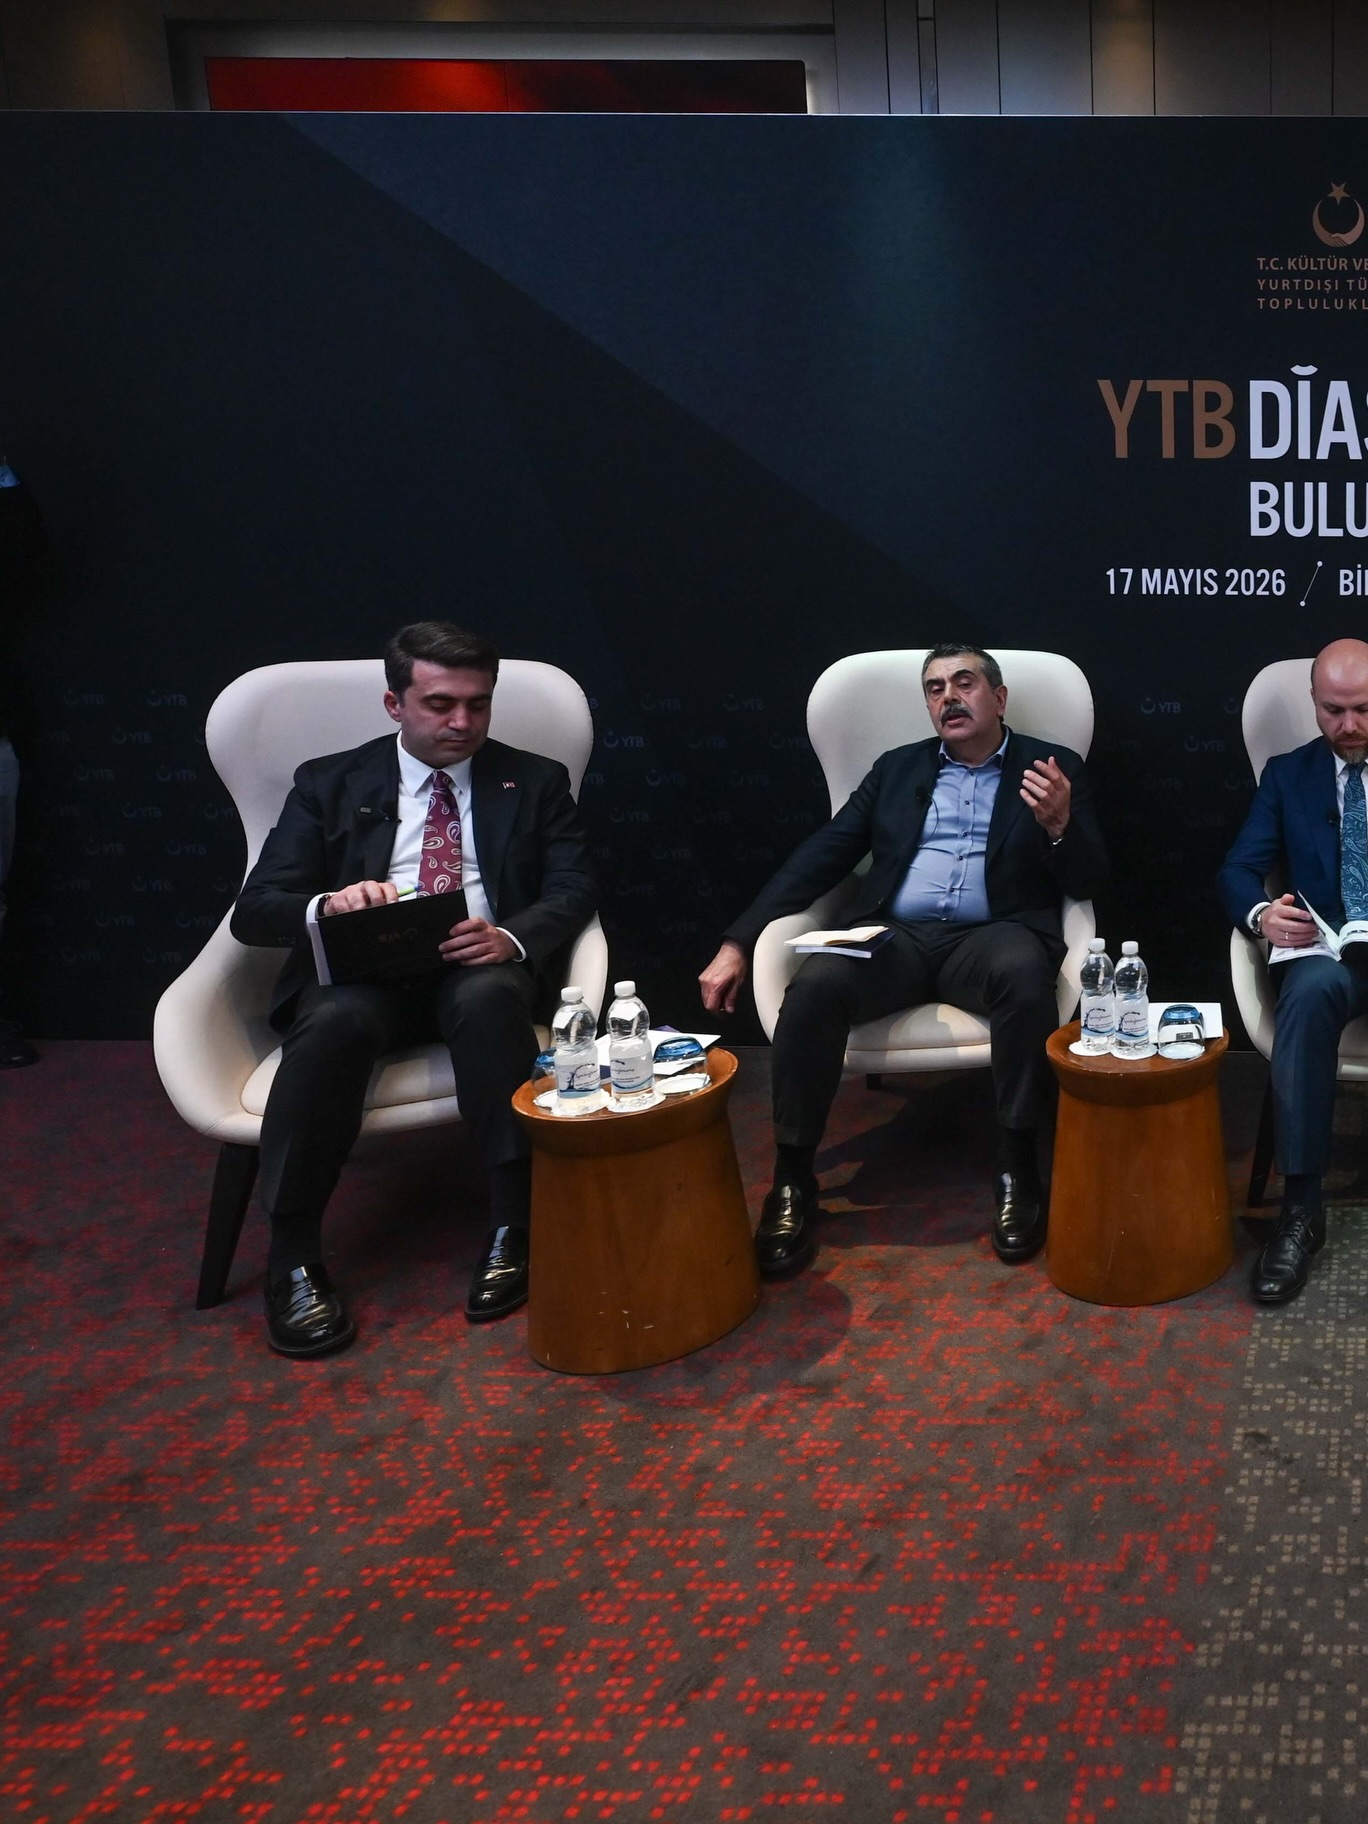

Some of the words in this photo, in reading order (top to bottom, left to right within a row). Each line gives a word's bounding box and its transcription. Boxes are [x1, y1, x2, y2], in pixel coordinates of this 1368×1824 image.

[1256, 257, 1284, 271] T.C.
[1287, 254, 1348, 271] KÜLTÜR
[1257, 278, 1339, 294] YURTDIŞI
[1096, 379, 1236, 459] YTB
[1105, 567, 1134, 595] 17
[1141, 568, 1219, 596] MAYIS
[1224, 568, 1286, 596] 2026
[163, 695, 187, 706] YTB
[1159, 702, 1182, 714] YTB
[622, 736, 644, 748] YTB
[1202, 740, 1225, 751] YTB
[174, 770, 197, 781] YTB
